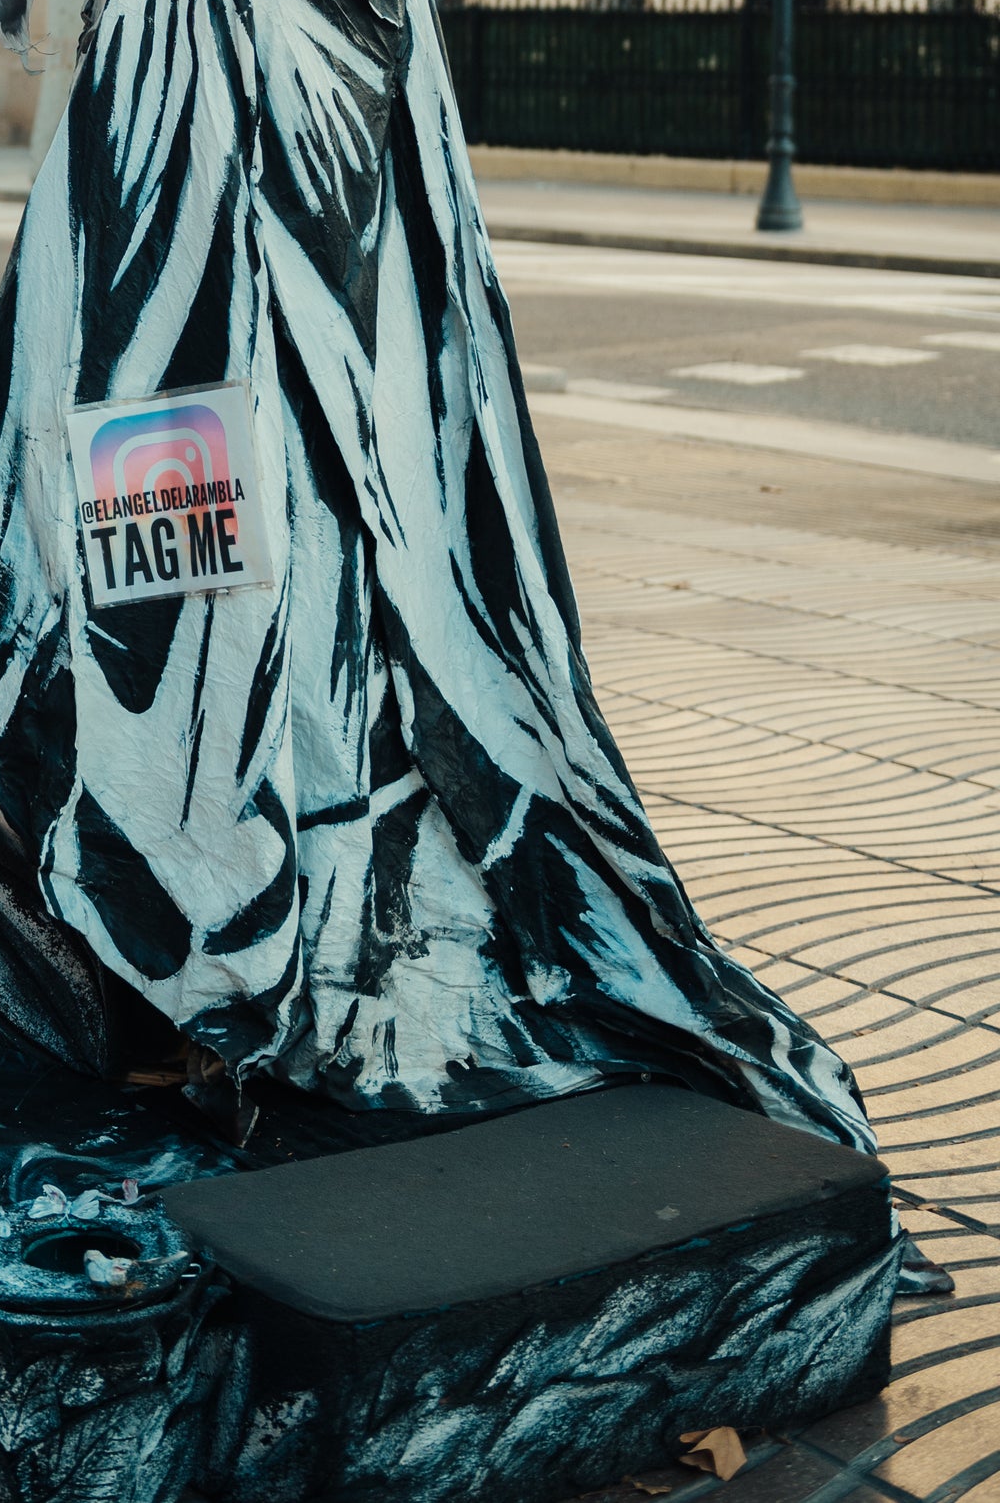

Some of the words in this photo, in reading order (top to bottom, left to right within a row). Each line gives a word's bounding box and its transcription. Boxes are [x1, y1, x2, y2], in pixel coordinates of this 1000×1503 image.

[81, 478, 246, 524] @ELANGELDELARAMBLA
[90, 517, 181, 590] TAG
[186, 508, 245, 578] ME
